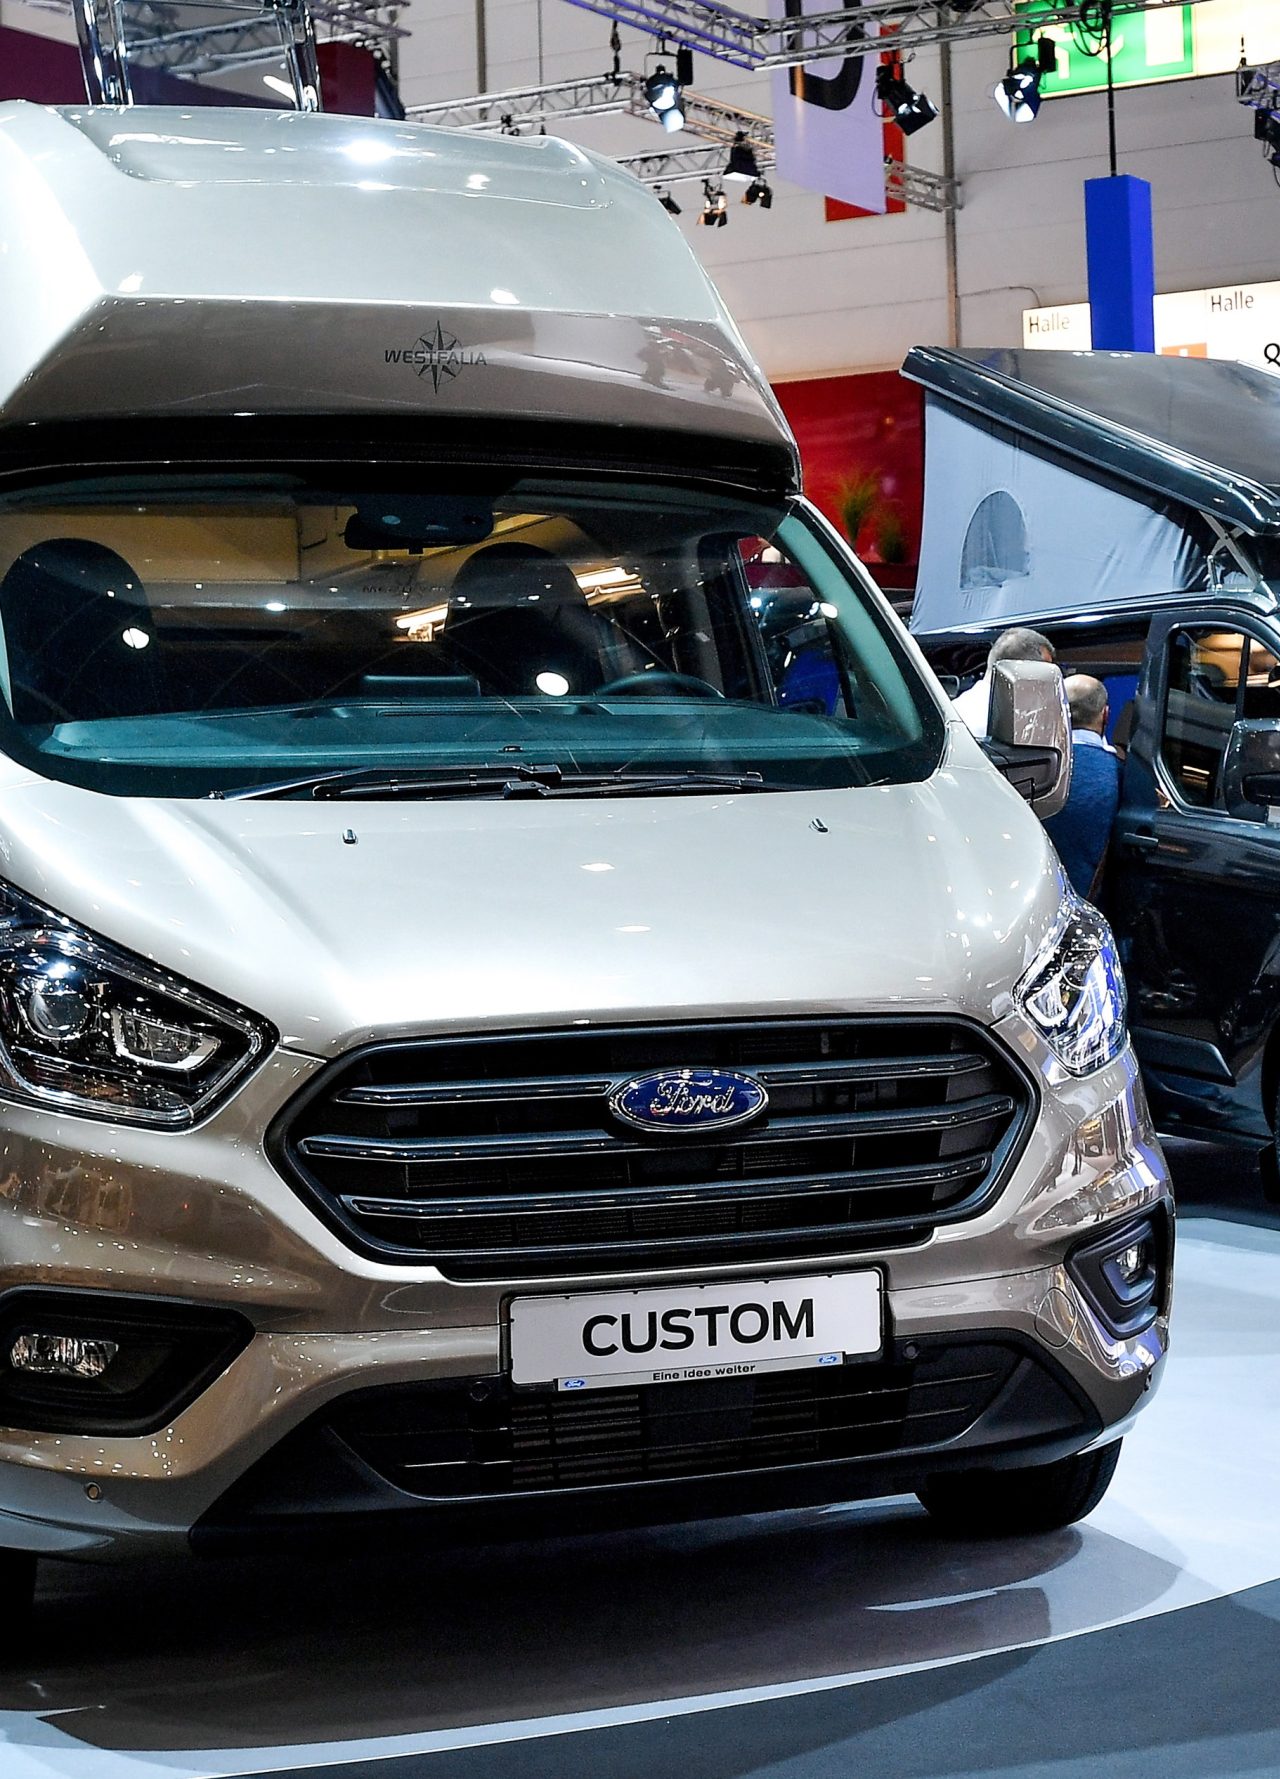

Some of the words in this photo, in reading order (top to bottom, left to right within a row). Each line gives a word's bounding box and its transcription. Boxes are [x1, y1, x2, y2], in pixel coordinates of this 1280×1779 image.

[1210, 290, 1255, 313] Halle
[1028, 311, 1071, 334] Halle
[384, 349, 488, 366] WESTFALIA
[649, 1079, 735, 1116] Ford
[581, 1297, 816, 1357] CUSTOM
[652, 1372, 680, 1382] Eine
[683, 1368, 712, 1379] Idee
[714, 1364, 756, 1376] weiter
